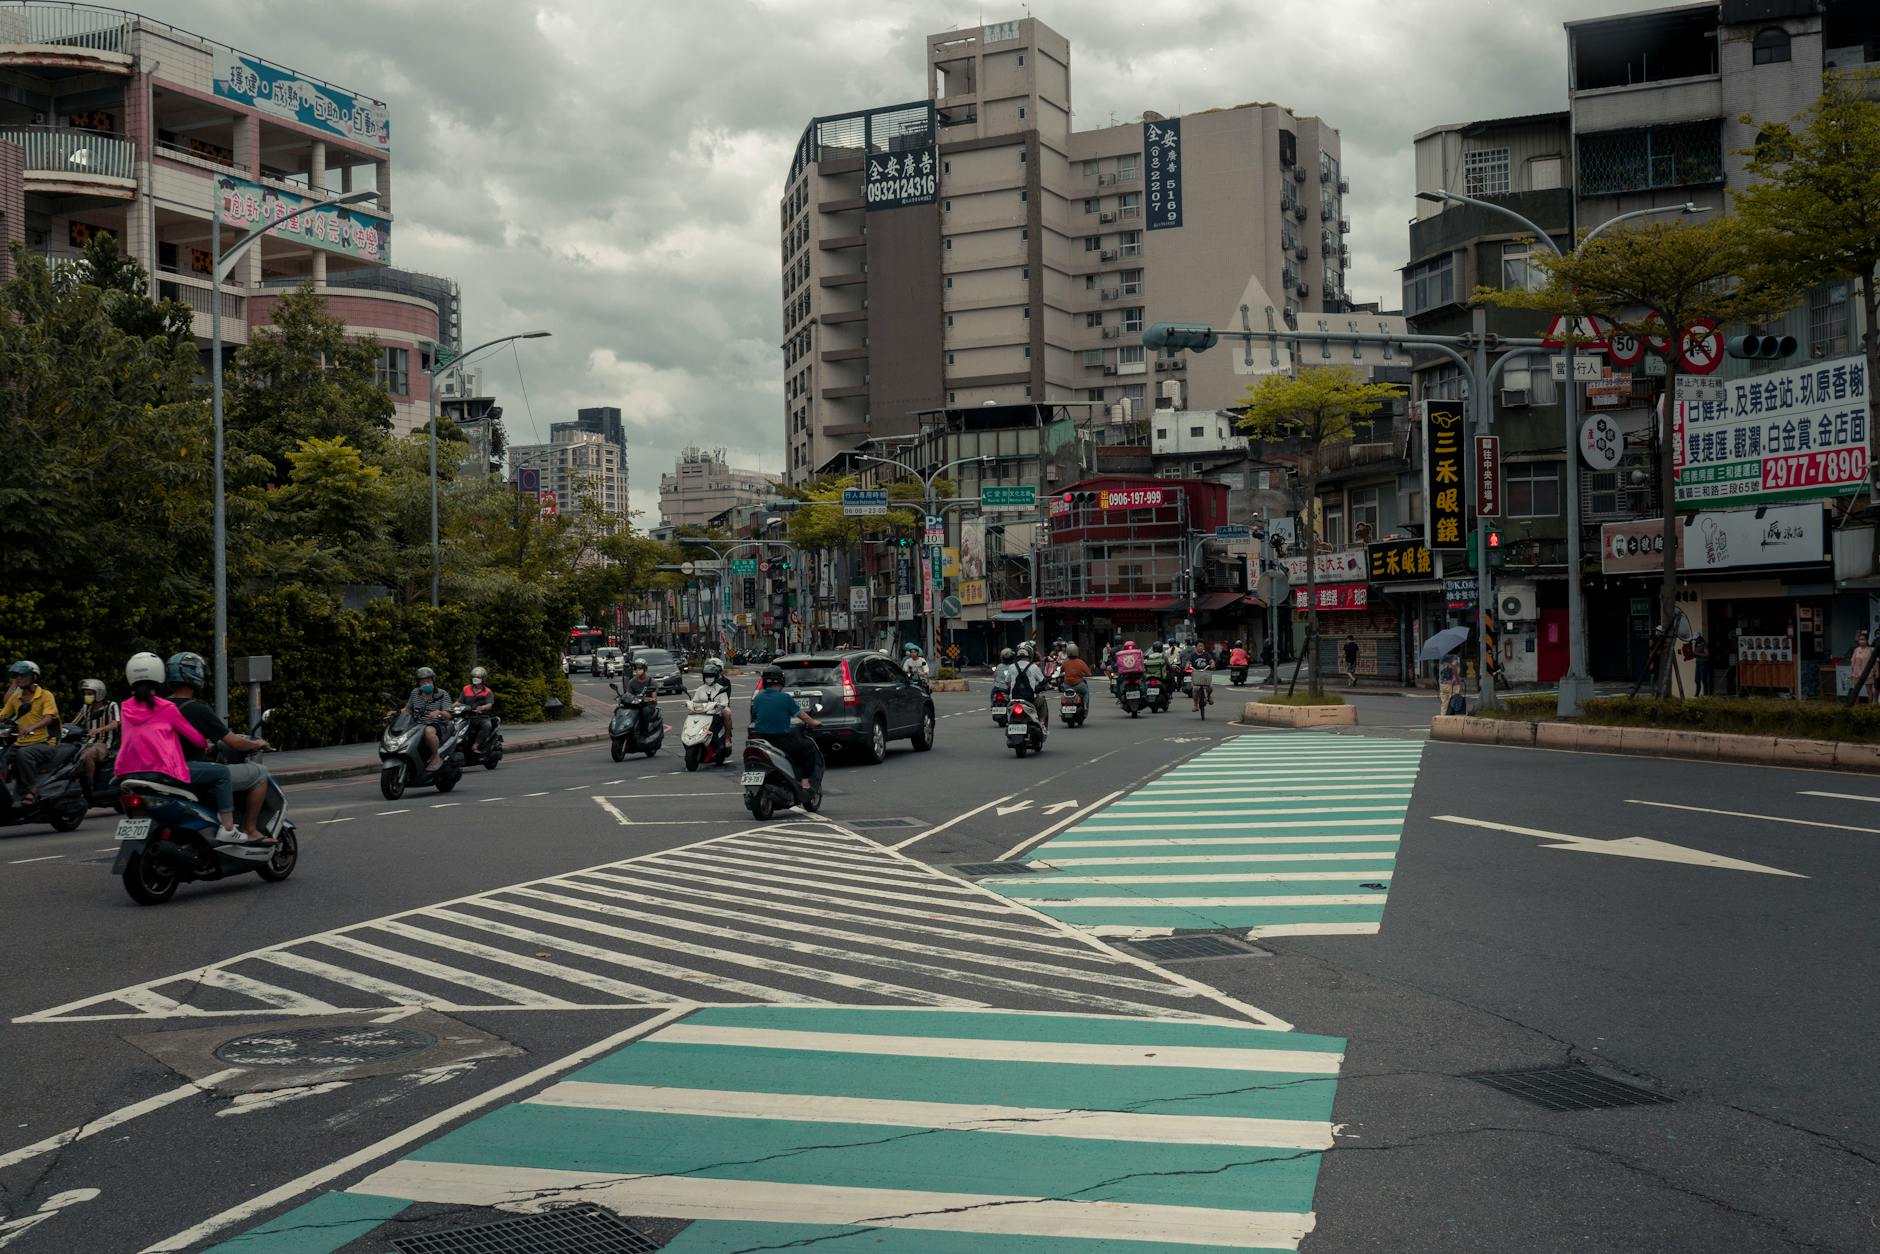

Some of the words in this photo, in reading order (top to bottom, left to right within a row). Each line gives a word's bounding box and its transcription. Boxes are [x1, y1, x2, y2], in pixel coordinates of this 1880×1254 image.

[868, 151, 934, 181] 全安廣告
[867, 174, 935, 203] 0932124316
[1166, 180, 1177, 221] 5169
[1616, 337, 1635, 352] 50
[1556, 362, 1598, 375] 當行人
[1482, 449, 1493, 501] 往中央市場
[1764, 449, 1864, 488] 2977-7890
[1109, 490, 1162, 506] 0906-197-999
[1434, 431, 1460, 543] 三禾眼鏡
[1674, 480, 1760, 500] 重區三和路三段65號
[925, 515, 937, 530] P
[927, 534, 938, 543] 10
[1372, 546, 1431, 576] 三禾眼鏡
